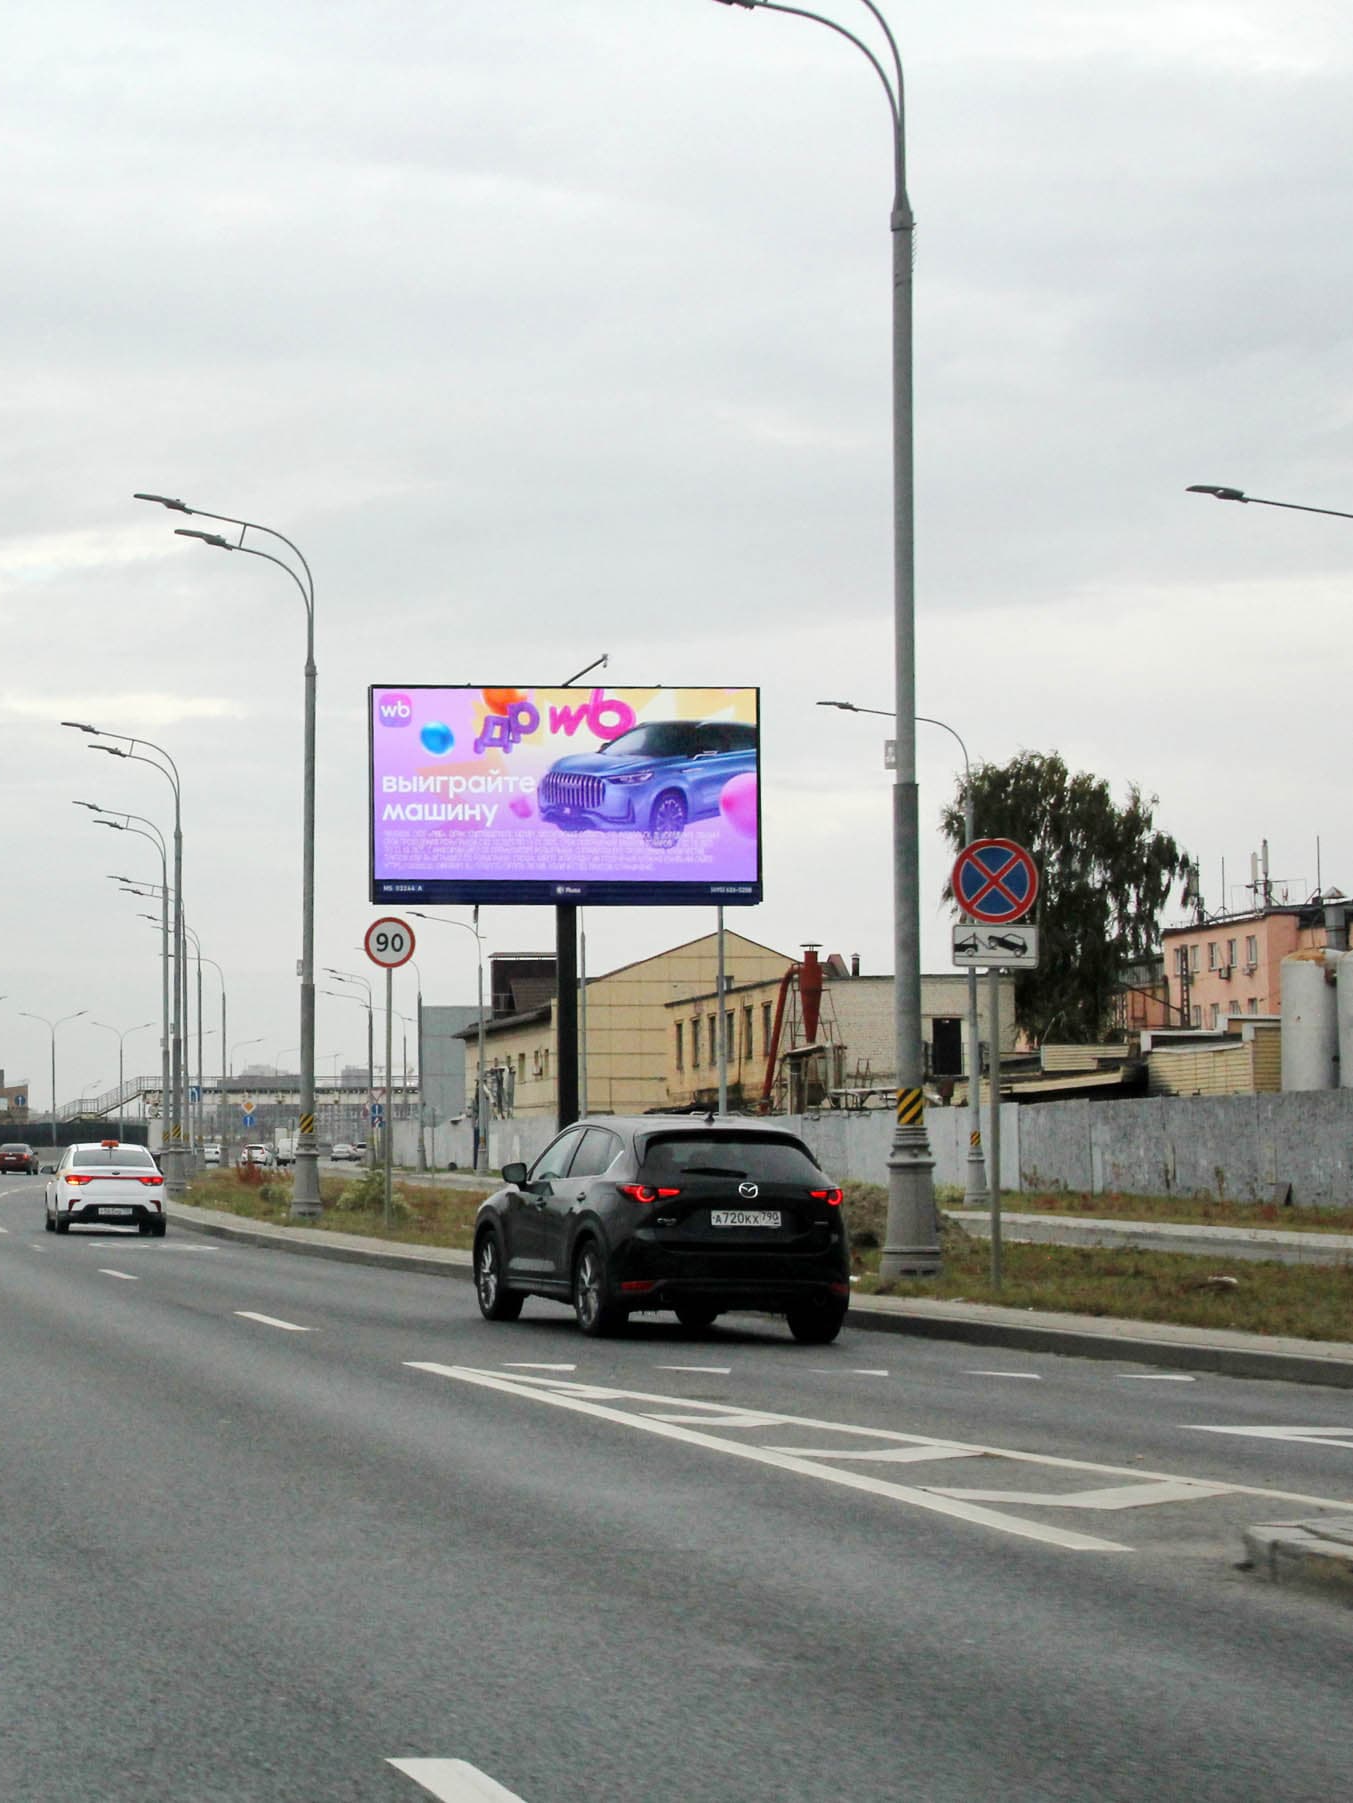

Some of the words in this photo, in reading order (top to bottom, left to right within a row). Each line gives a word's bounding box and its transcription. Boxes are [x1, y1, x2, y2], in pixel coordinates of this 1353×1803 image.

[381, 701, 411, 719] wb
[382, 769, 536, 799] выиграйте
[382, 803, 498, 827] машину
[376, 933, 404, 953] 90
